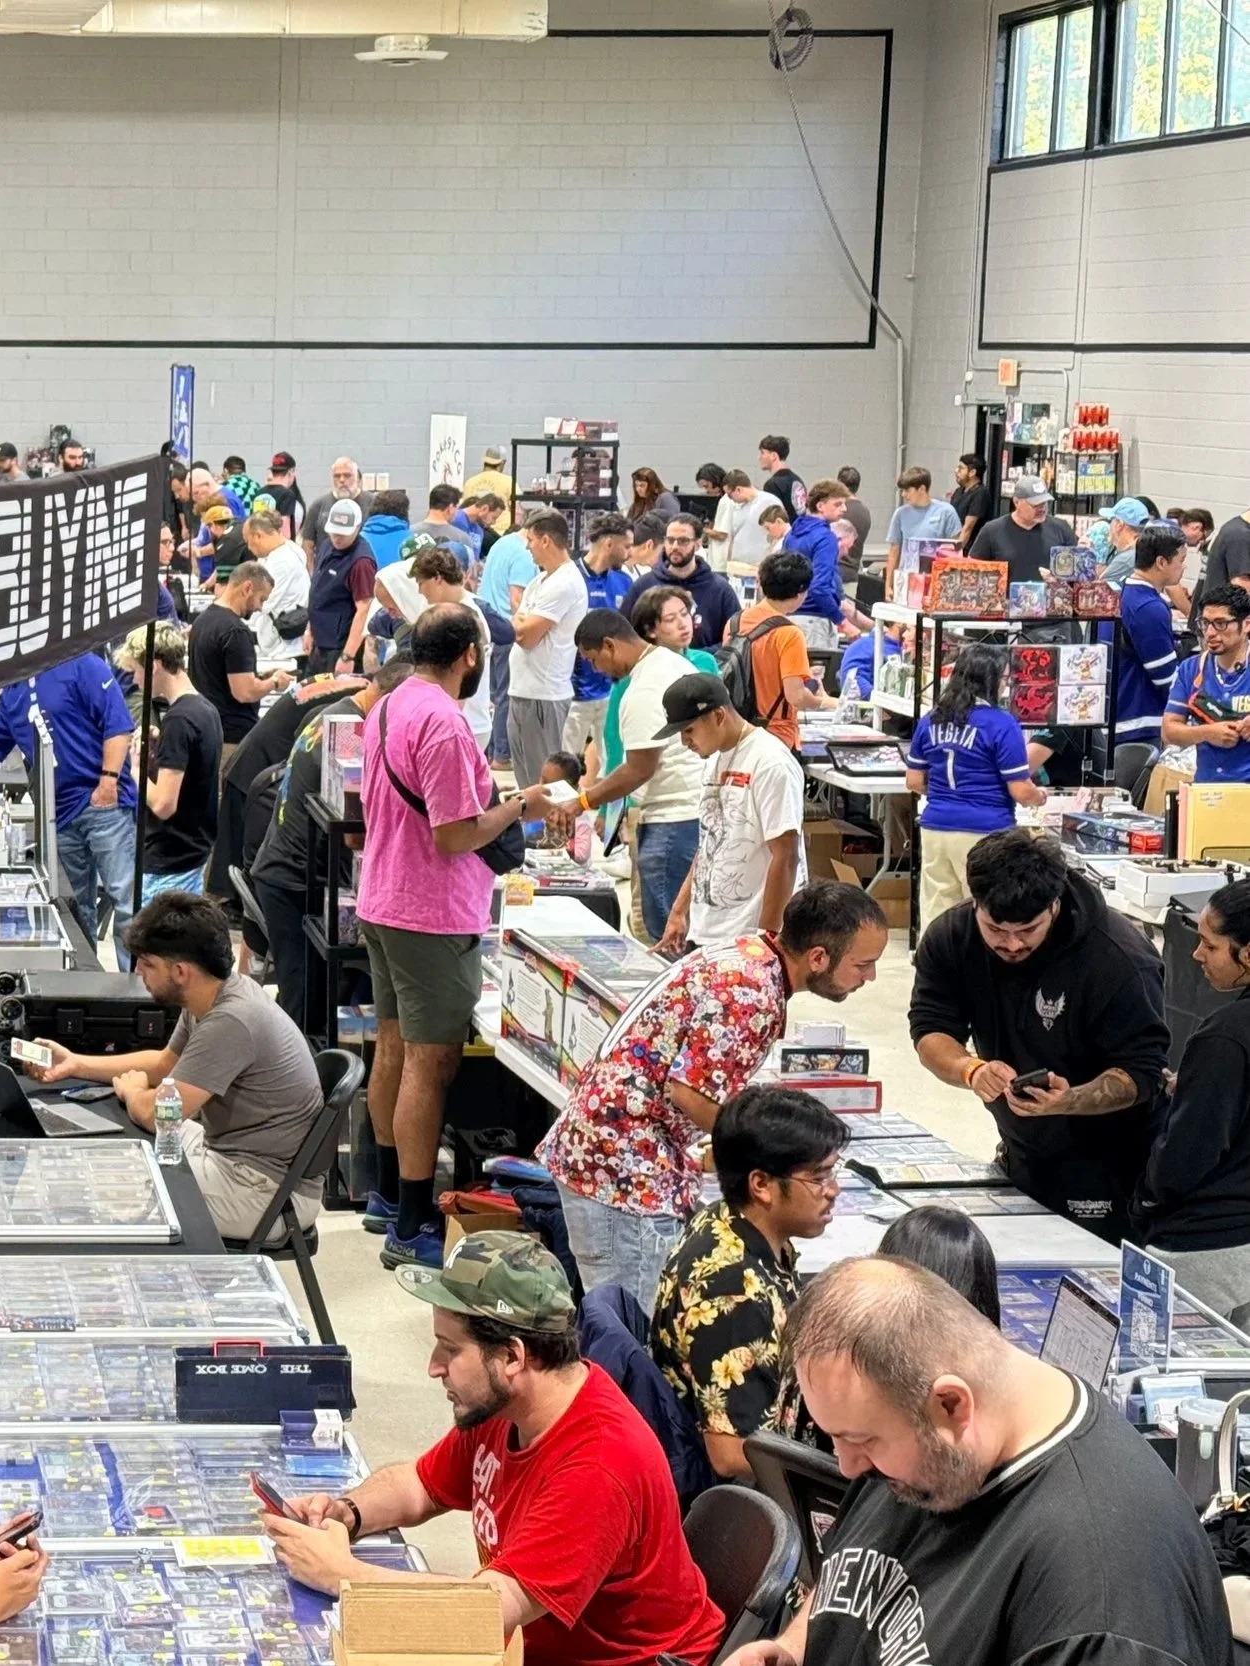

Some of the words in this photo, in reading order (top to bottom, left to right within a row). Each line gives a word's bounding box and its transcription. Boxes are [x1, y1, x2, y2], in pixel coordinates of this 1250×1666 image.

[929, 722, 977, 750] VEGETA
[195, 1364, 228, 1375] BOX
[280, 1364, 312, 1374] THE
[810, 1548, 898, 1631] NEW
